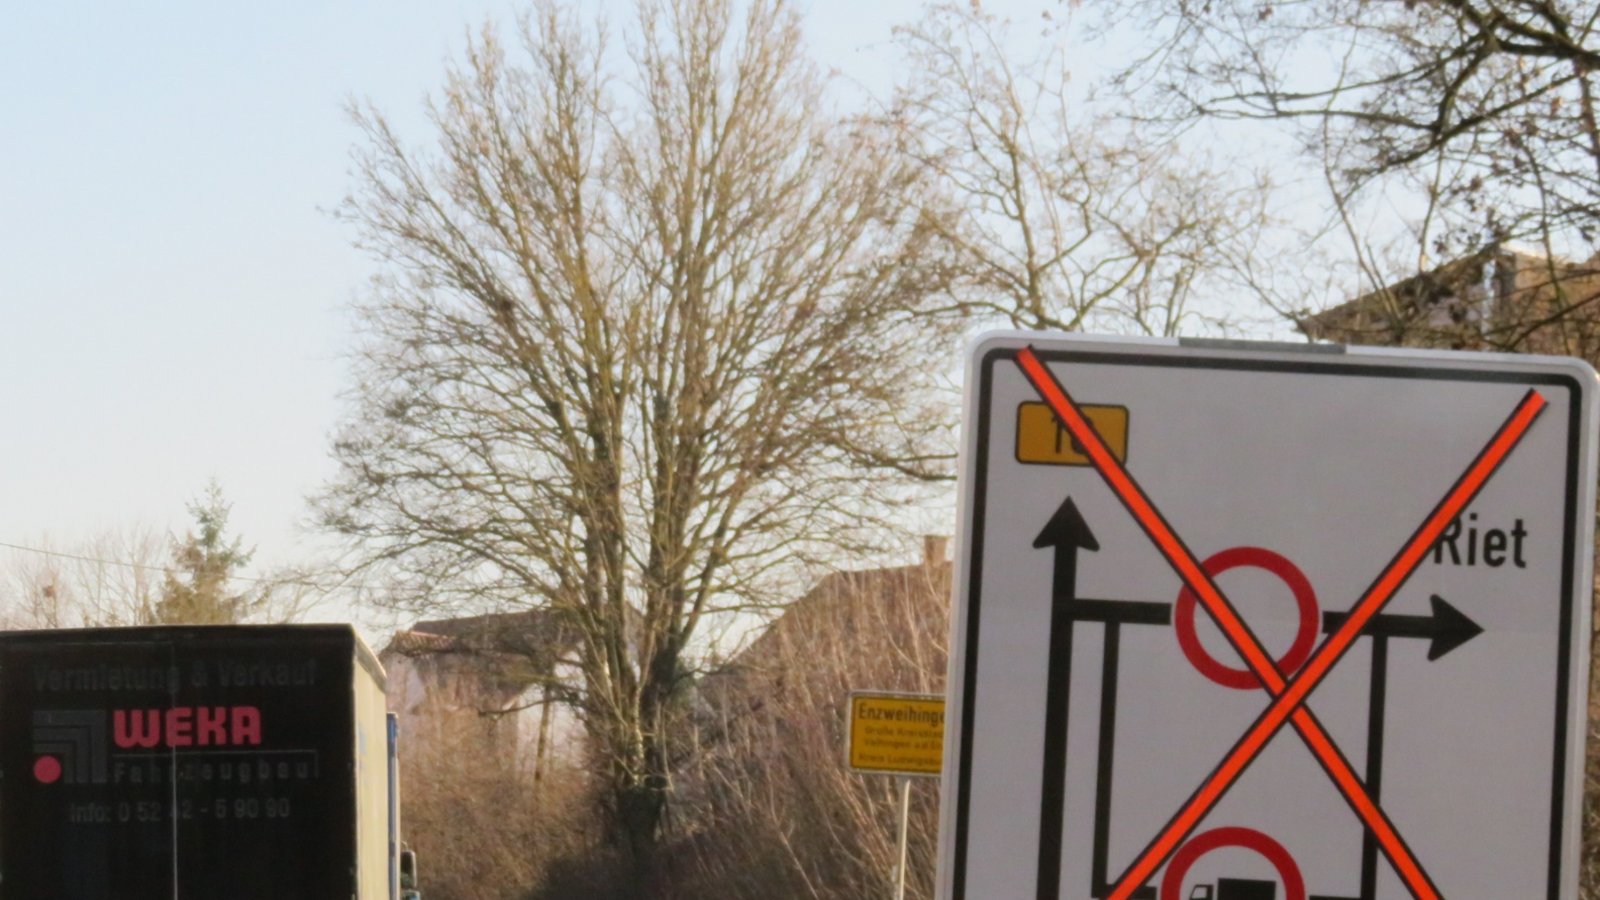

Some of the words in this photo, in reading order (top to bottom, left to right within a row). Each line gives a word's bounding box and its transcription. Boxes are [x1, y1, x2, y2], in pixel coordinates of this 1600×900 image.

[1433, 512, 1527, 569] Riet
[218, 657, 317, 688] Verkauf
[112, 705, 262, 749] WEKA
